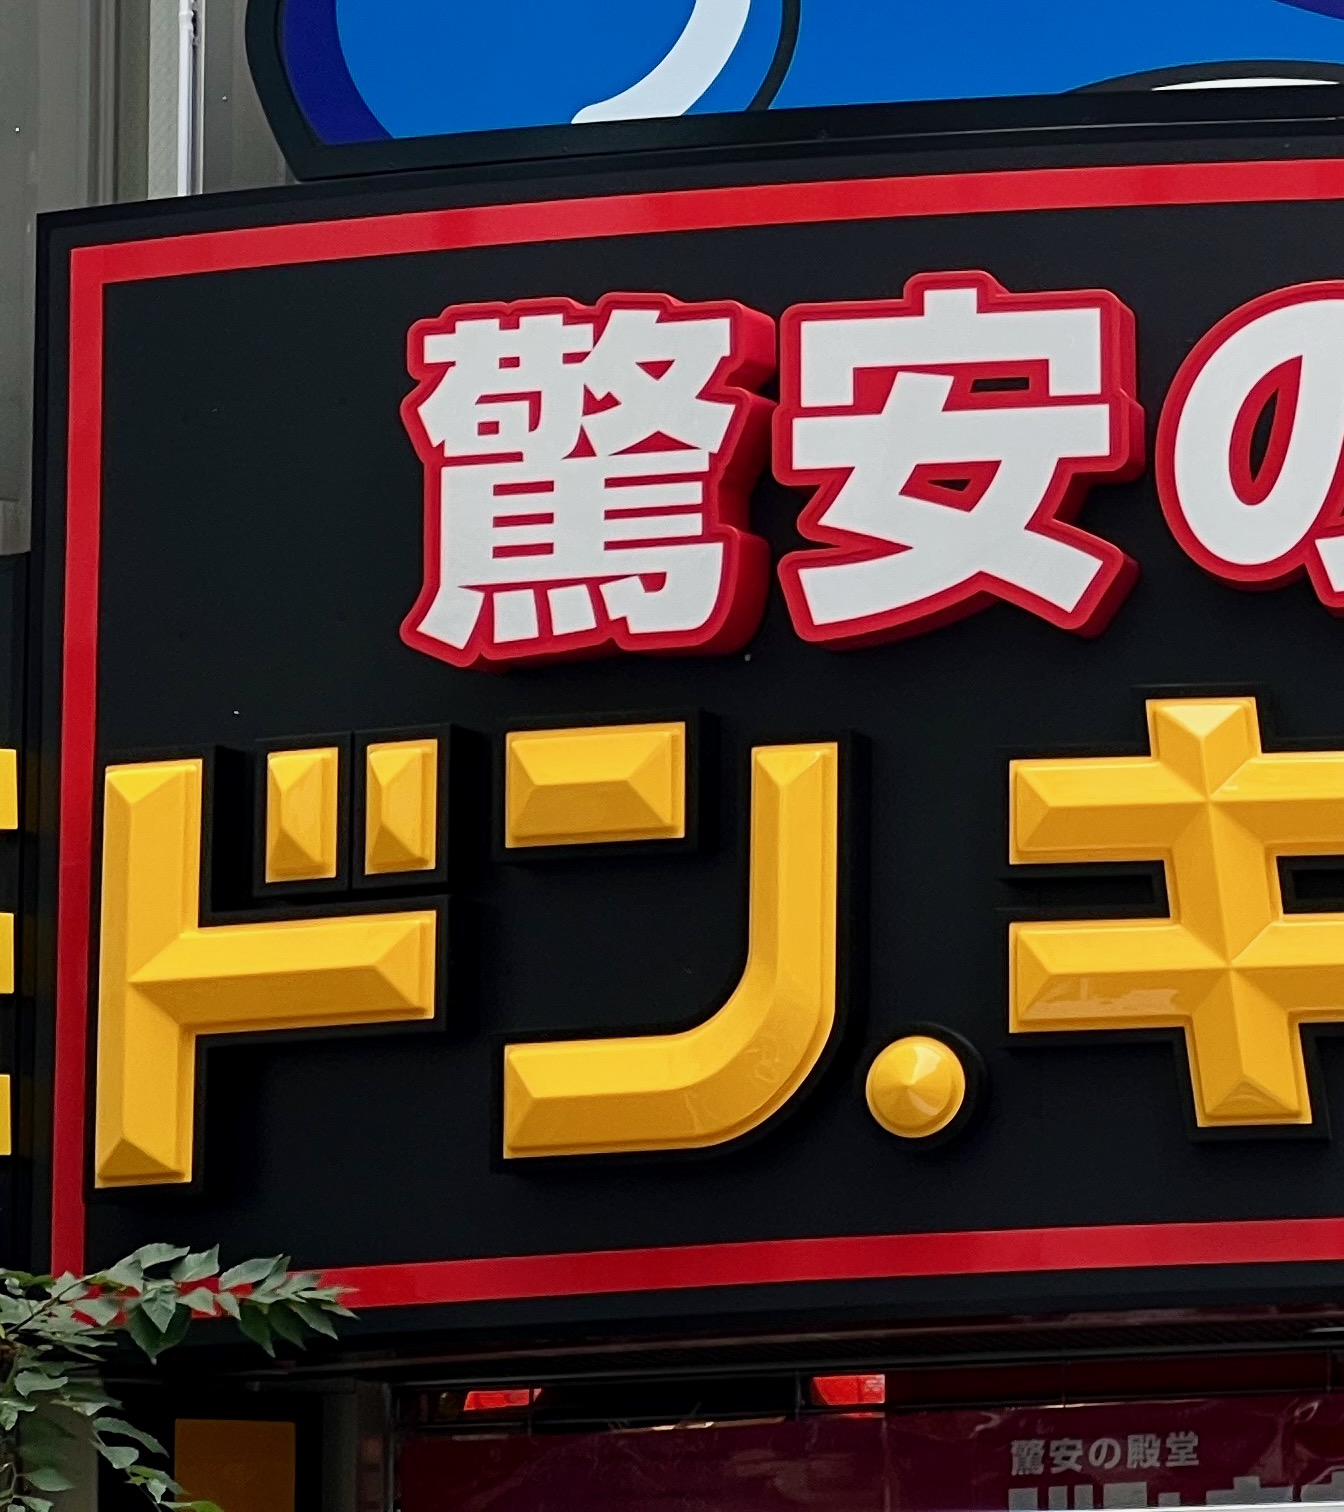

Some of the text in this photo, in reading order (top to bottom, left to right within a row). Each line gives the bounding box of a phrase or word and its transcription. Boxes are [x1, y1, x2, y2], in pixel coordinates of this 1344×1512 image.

[1010, 1431, 1201, 1476] 驚安の殿堂
